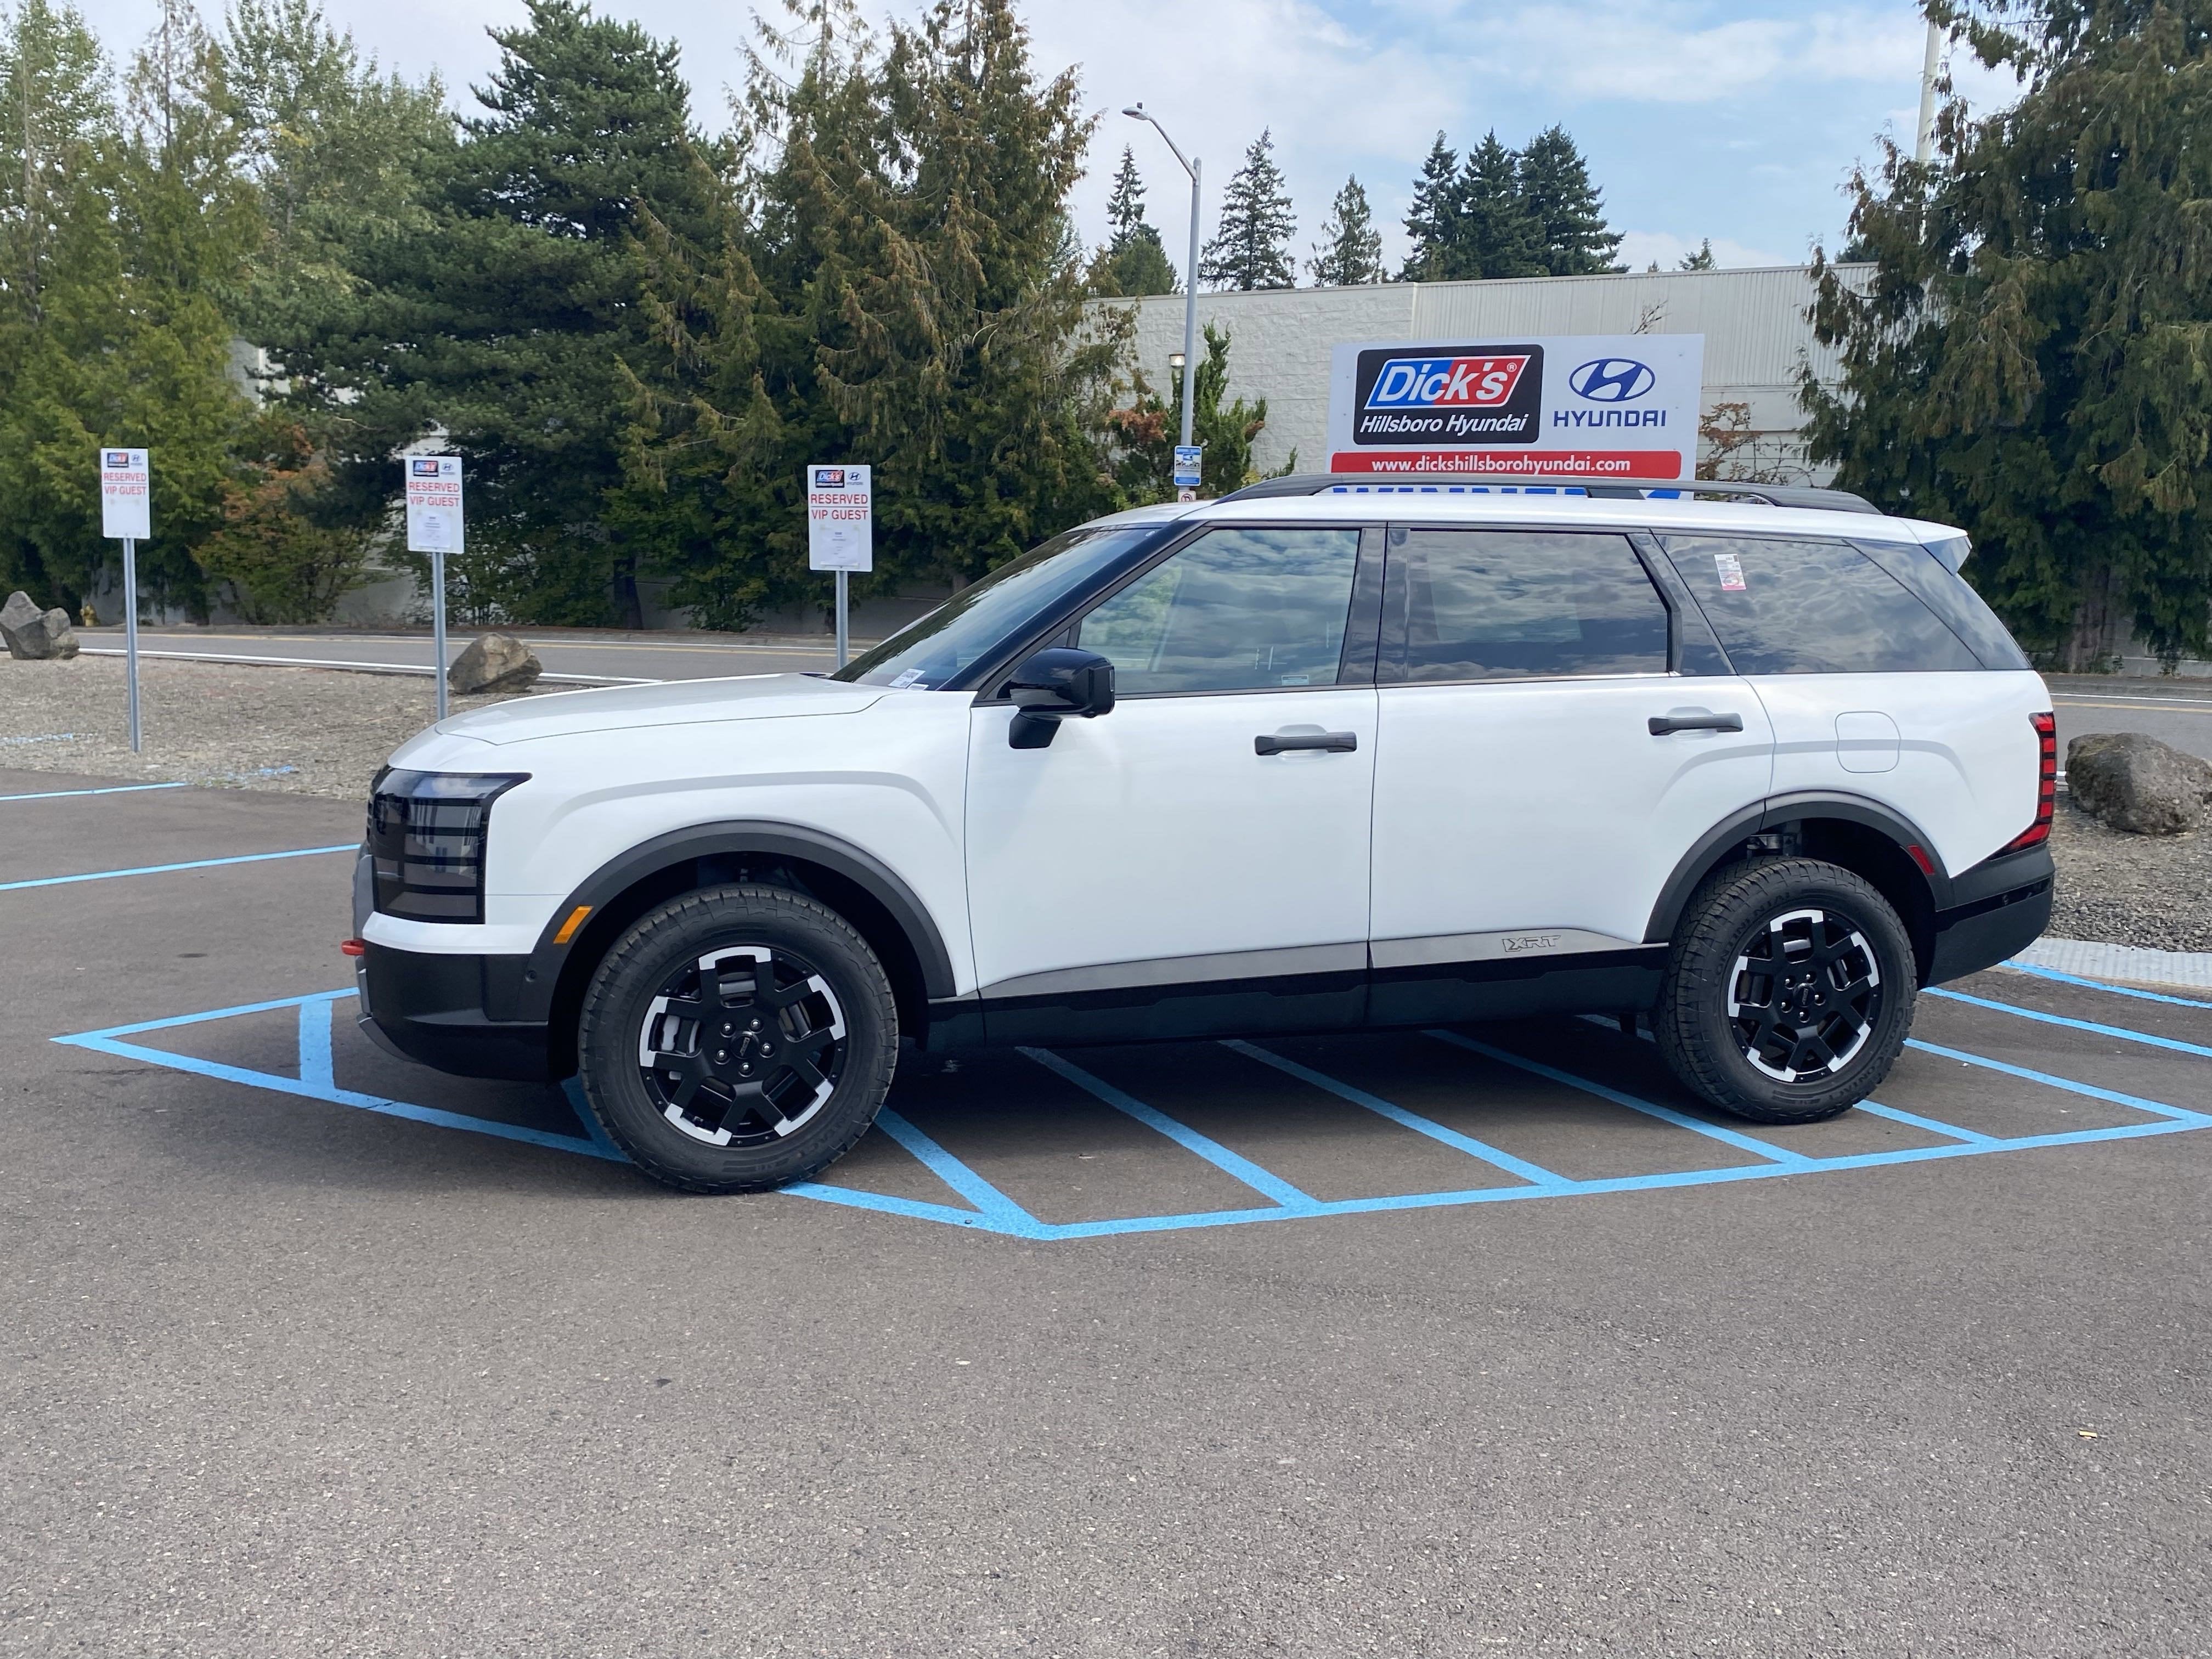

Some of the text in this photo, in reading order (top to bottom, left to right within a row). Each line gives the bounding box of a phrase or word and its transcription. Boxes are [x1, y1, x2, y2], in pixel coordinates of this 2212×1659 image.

[1553, 410, 1667, 427] HYUNDAI
[1359, 413, 1530, 436] Hillsboro Hyundai
[1372, 454, 1631, 475] www.dickshillsborohyundai.com
[104, 472, 146, 482] RESERVED
[104, 486, 146, 495] VIP GUEST
[409, 482, 460, 492] RESERVED
[410, 496, 460, 507] VIP GUEST
[811, 494, 868, 504] RESERVED
[811, 510, 868, 520] VIP GUEST
[1502, 935, 1561, 952] XRT
